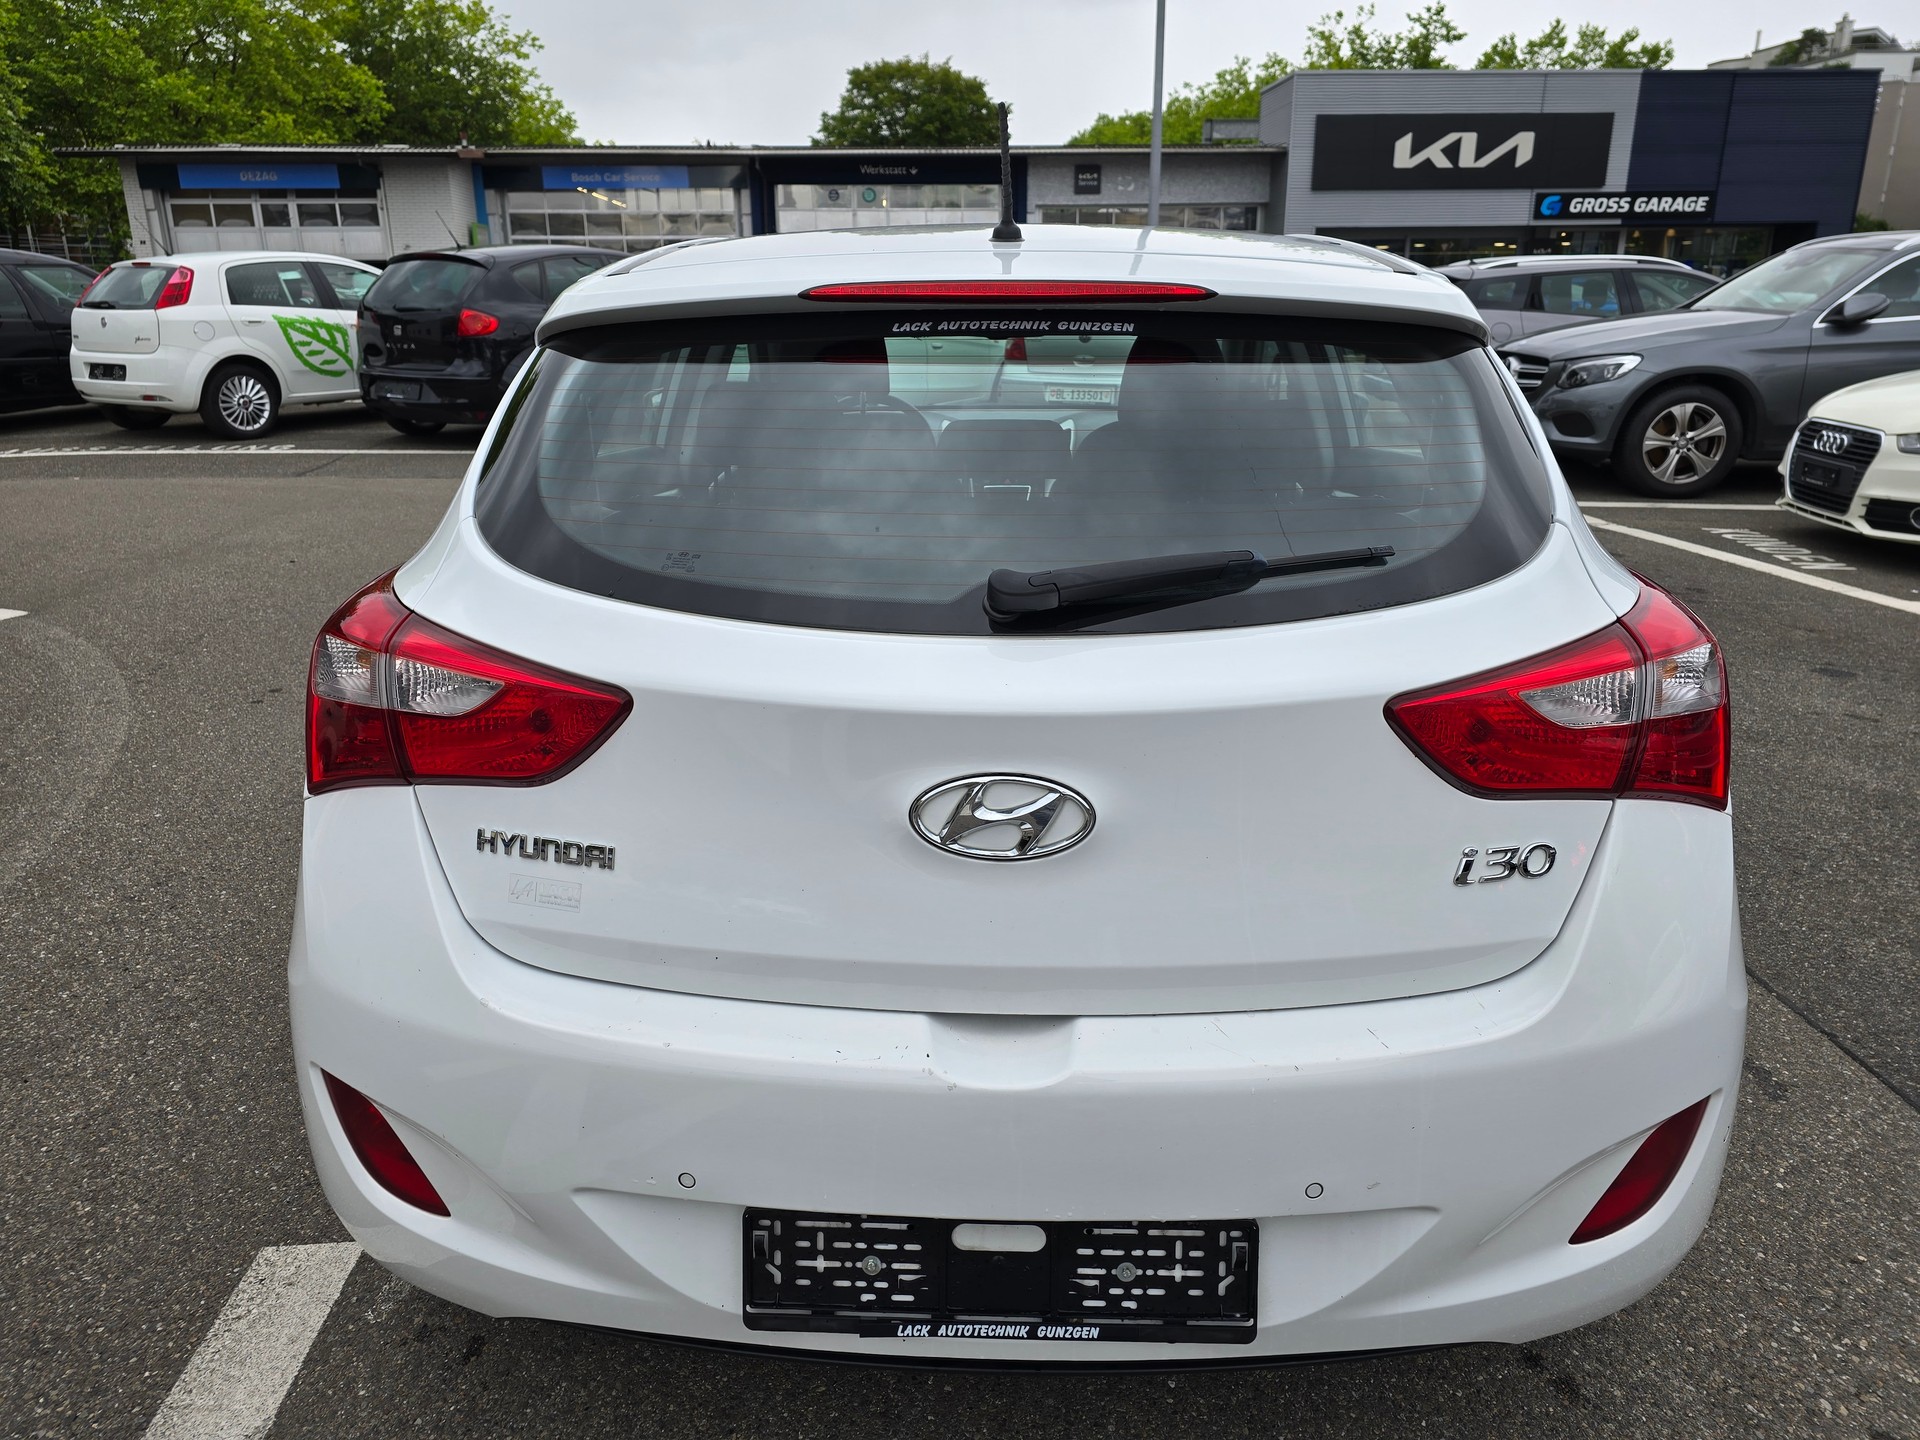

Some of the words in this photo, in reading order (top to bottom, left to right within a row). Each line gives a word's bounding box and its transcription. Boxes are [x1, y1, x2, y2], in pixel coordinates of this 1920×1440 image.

[1393, 131, 1535, 168] KIA
[571, 172, 601, 182] Bosch
[603, 172, 621, 182] Car
[623, 172, 661, 182] Service
[860, 164, 907, 175] Werkstatt
[1569, 197, 1631, 213] GROSS
[1633, 196, 1709, 213] GARAGE
[892, 321, 932, 332] LACK
[937, 320, 1051, 331] AUTOTECHNIK
[1057, 321, 1135, 332] GUNZGEN
[476, 827, 616, 870] HYUNDAI
[1453, 842, 1557, 887] i30
[896, 1324, 931, 1338] LACK
[937, 1324, 1030, 1338] AUTOTECHNIK
[1037, 1325, 1100, 1339] GUNZGEN
